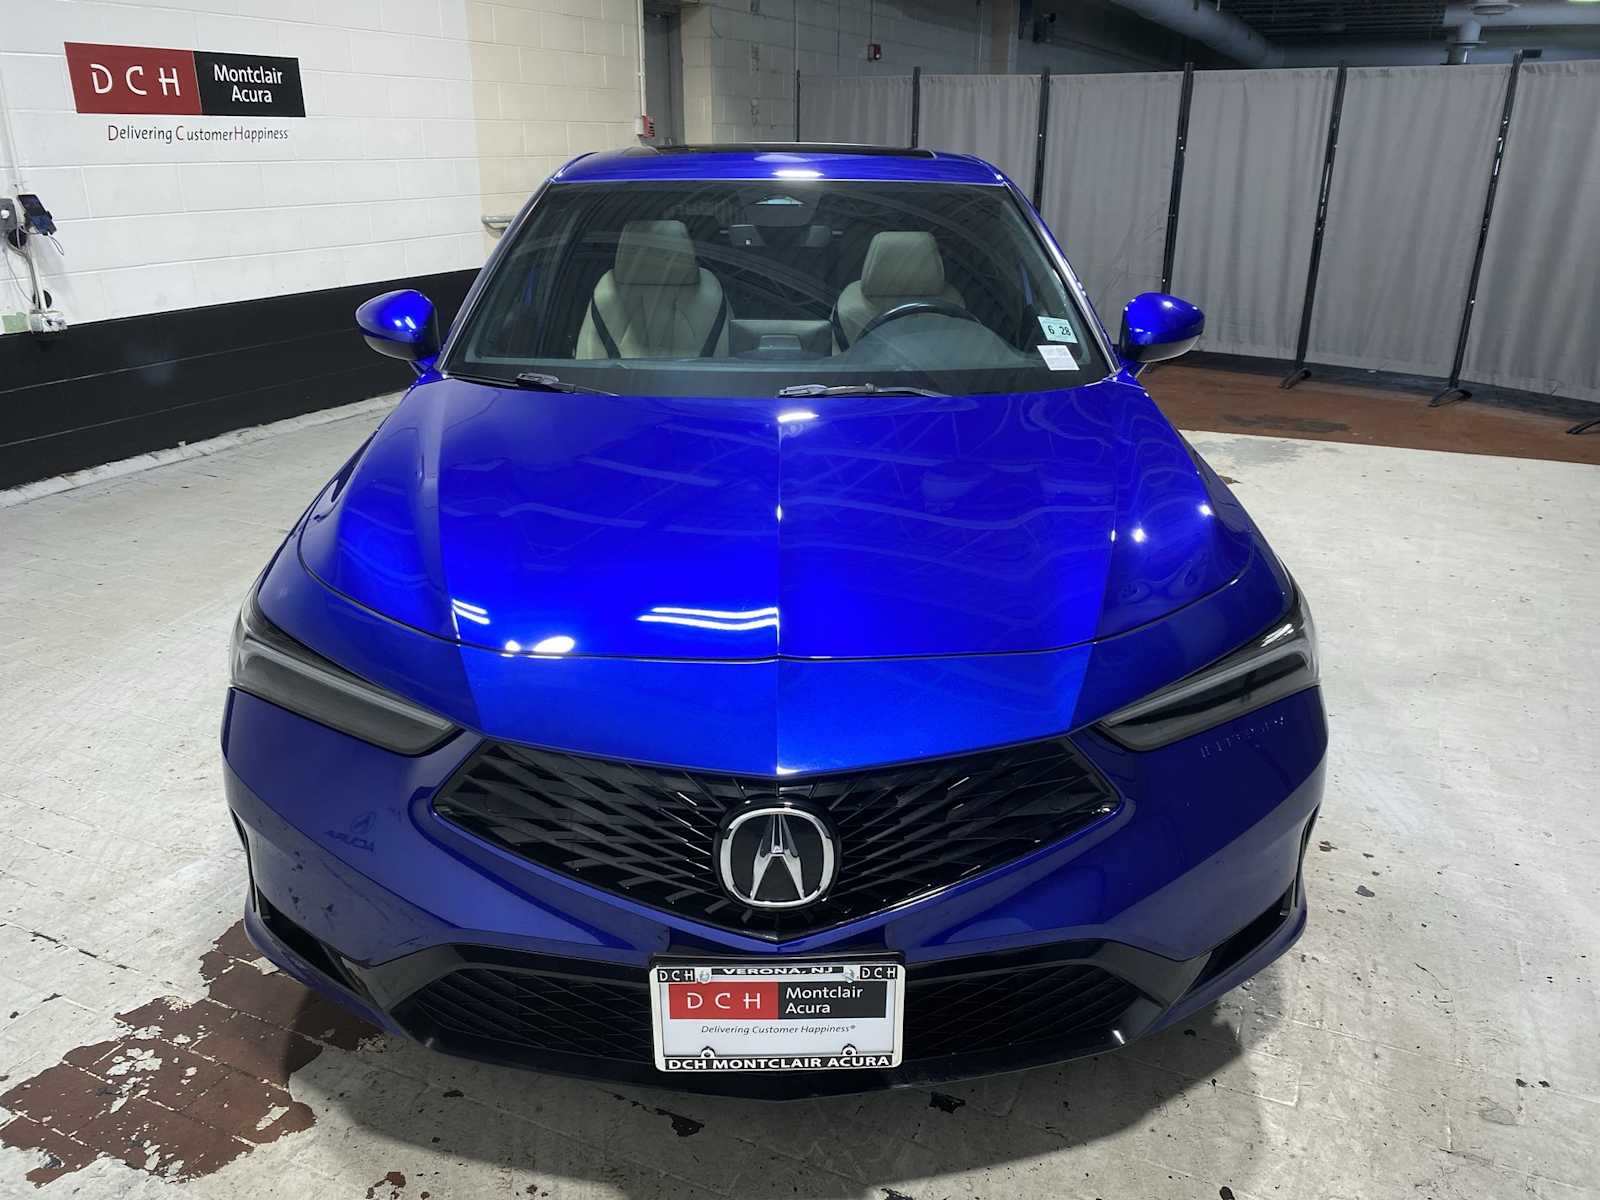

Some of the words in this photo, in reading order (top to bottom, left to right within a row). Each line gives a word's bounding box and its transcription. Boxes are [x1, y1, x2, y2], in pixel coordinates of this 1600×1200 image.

[213, 64, 283, 85] Montclair
[231, 85, 273, 103] Acura
[107, 125, 173, 144] Delivering
[234, 125, 289, 143] Happiness
[1047, 325, 1055, 335] 6
[659, 969, 695, 981] DCH
[723, 967, 807, 976] VERONA,
[811, 966, 833, 974] NJ
[861, 967, 896, 979] DCH
[785, 986, 864, 1000] Montclair
[687, 992, 761, 1010] DCH
[785, 1002, 831, 1015] Acura
[701, 1025, 750, 1036] Delivering
[752, 1026, 798, 1034] Customer
[668, 1060, 707, 1071] DCH
[712, 1057, 822, 1070] MONTCLAIR
[827, 1056, 890, 1068] ACURA
